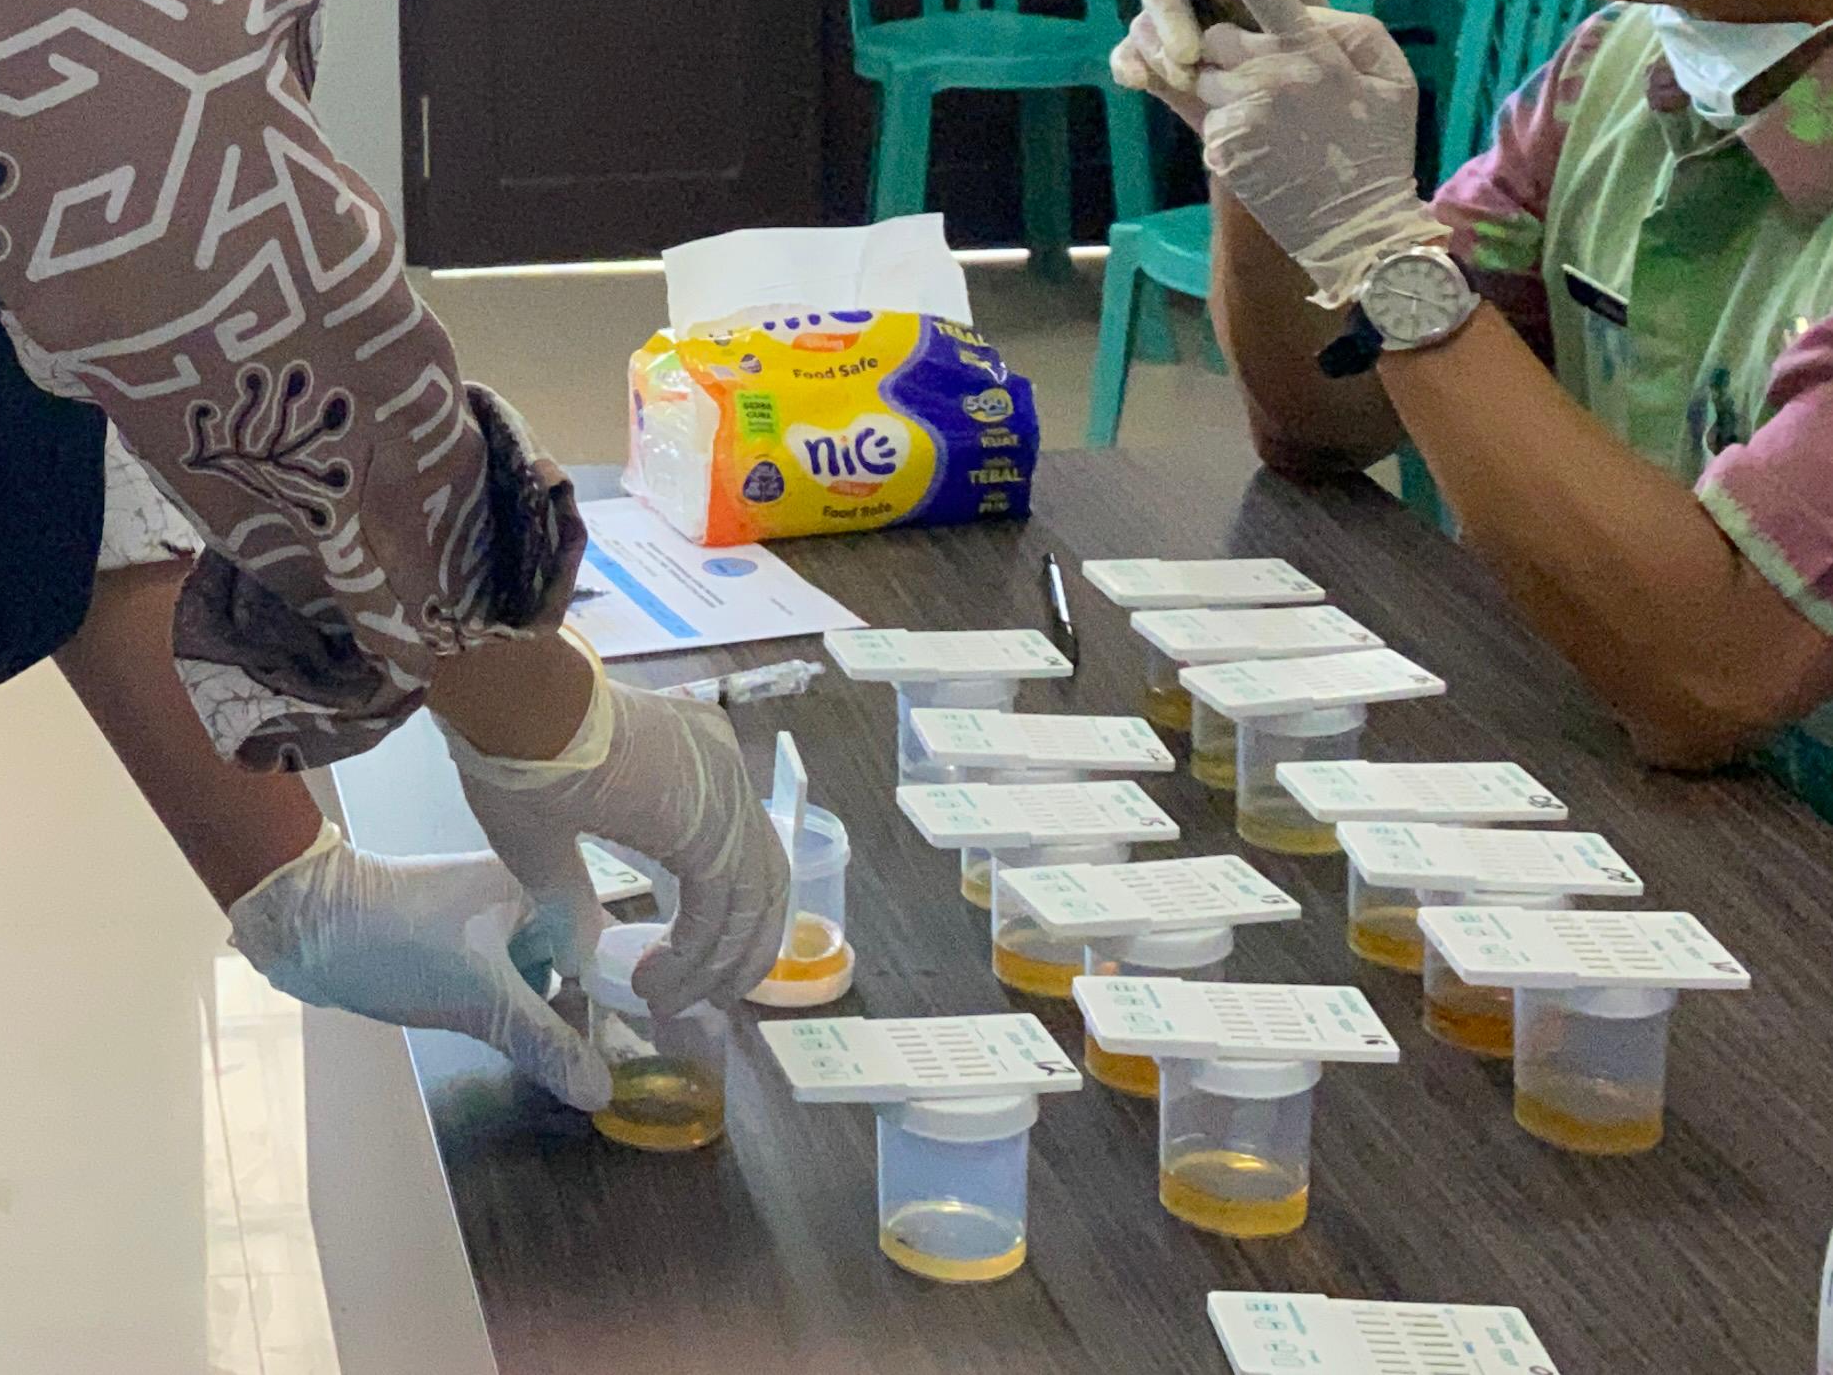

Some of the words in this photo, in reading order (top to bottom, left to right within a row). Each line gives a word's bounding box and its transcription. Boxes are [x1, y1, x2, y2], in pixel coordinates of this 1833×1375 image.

[793, 367, 835, 380] Food
[838, 356, 879, 378] Safe
[968, 468, 1025, 485] TEBAL
